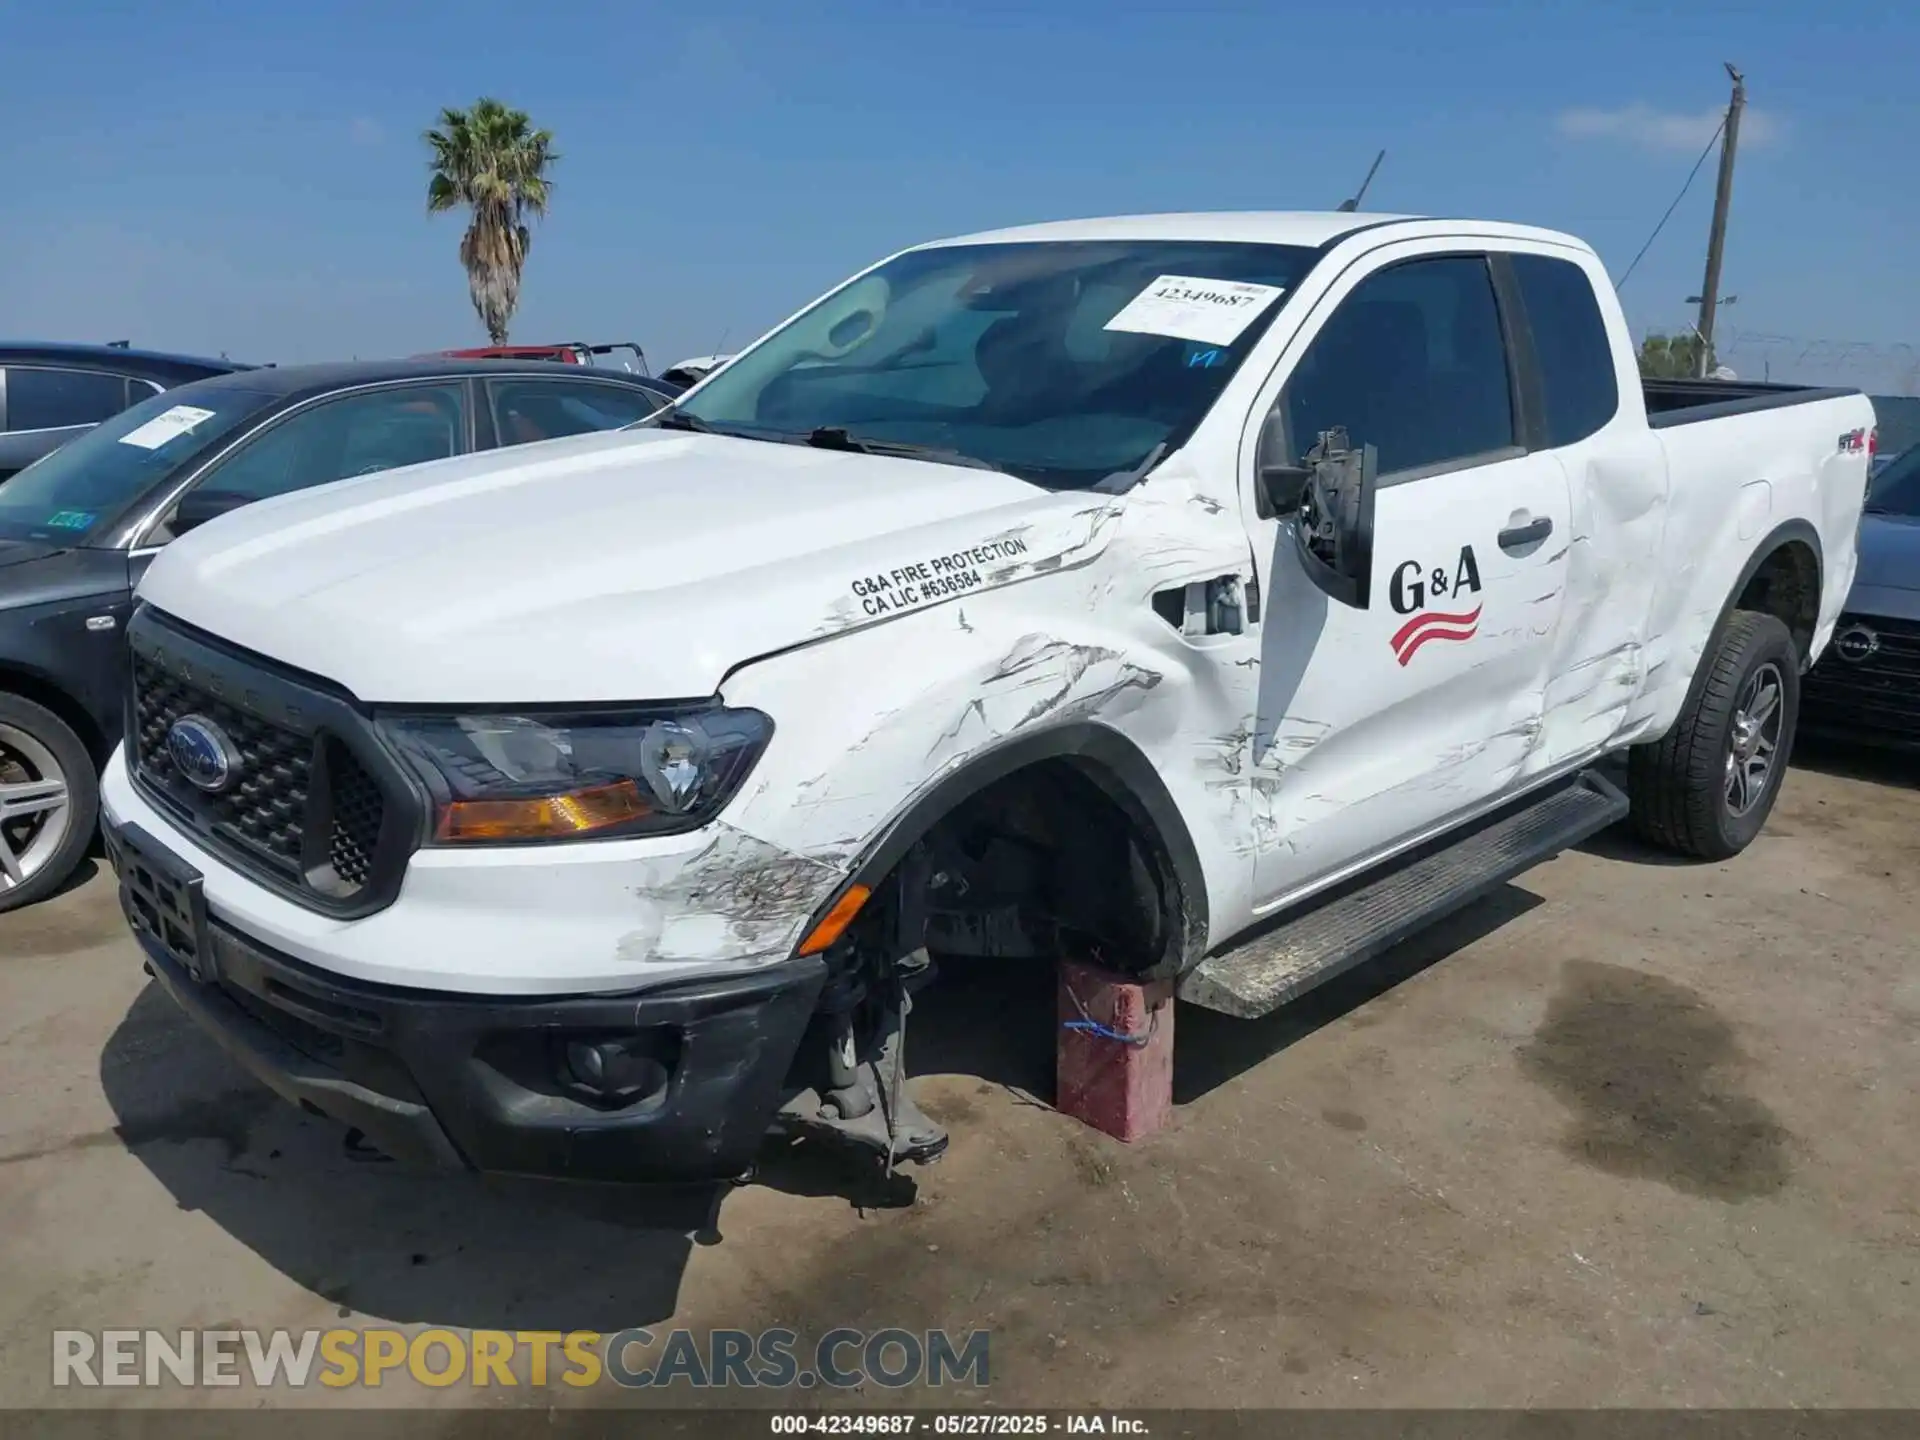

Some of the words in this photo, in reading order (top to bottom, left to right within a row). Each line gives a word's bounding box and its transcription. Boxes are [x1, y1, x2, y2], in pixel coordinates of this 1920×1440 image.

[1153, 287, 1256, 308] 42349687
[852, 574, 893, 597] G&A
[890, 563, 932, 587] FIRE
[930, 539, 1028, 575] PROTECTION
[862, 595, 891, 616] CA
[889, 587, 919, 609] LIC
[920, 569, 982, 600] #636584
